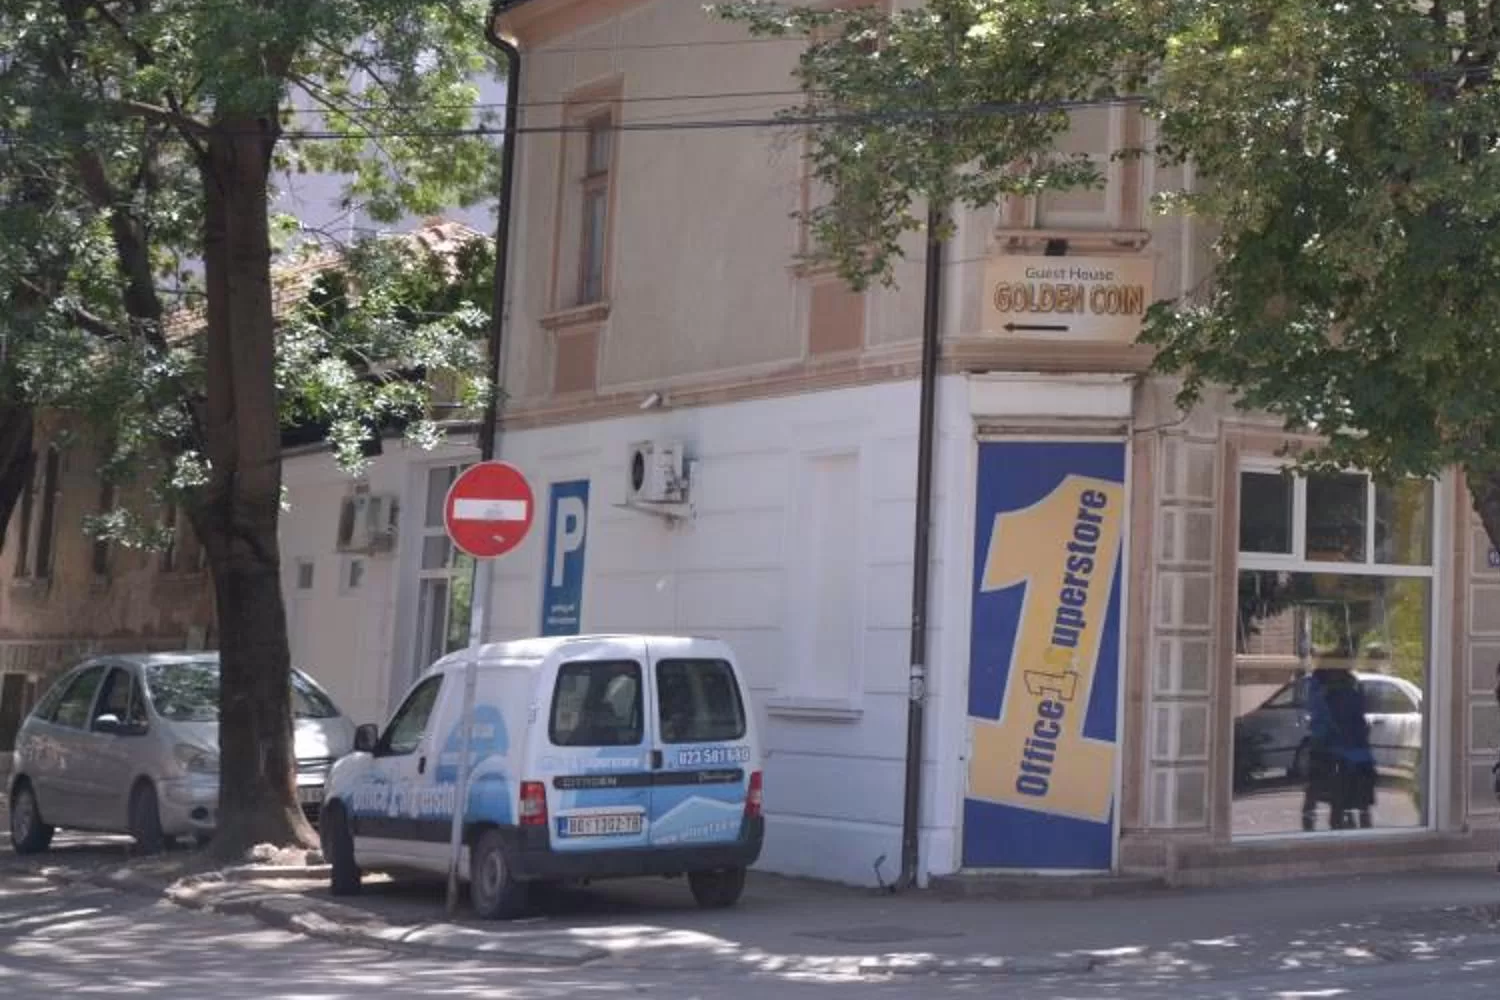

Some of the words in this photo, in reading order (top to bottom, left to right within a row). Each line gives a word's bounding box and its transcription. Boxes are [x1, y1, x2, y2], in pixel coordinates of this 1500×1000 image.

[1024, 267, 1066, 279] Guest
[1069, 267, 1115, 281] House
[994, 281, 1085, 314] GOLDEN
[1089, 283, 1145, 315] COIN
[552, 496, 585, 587] P
